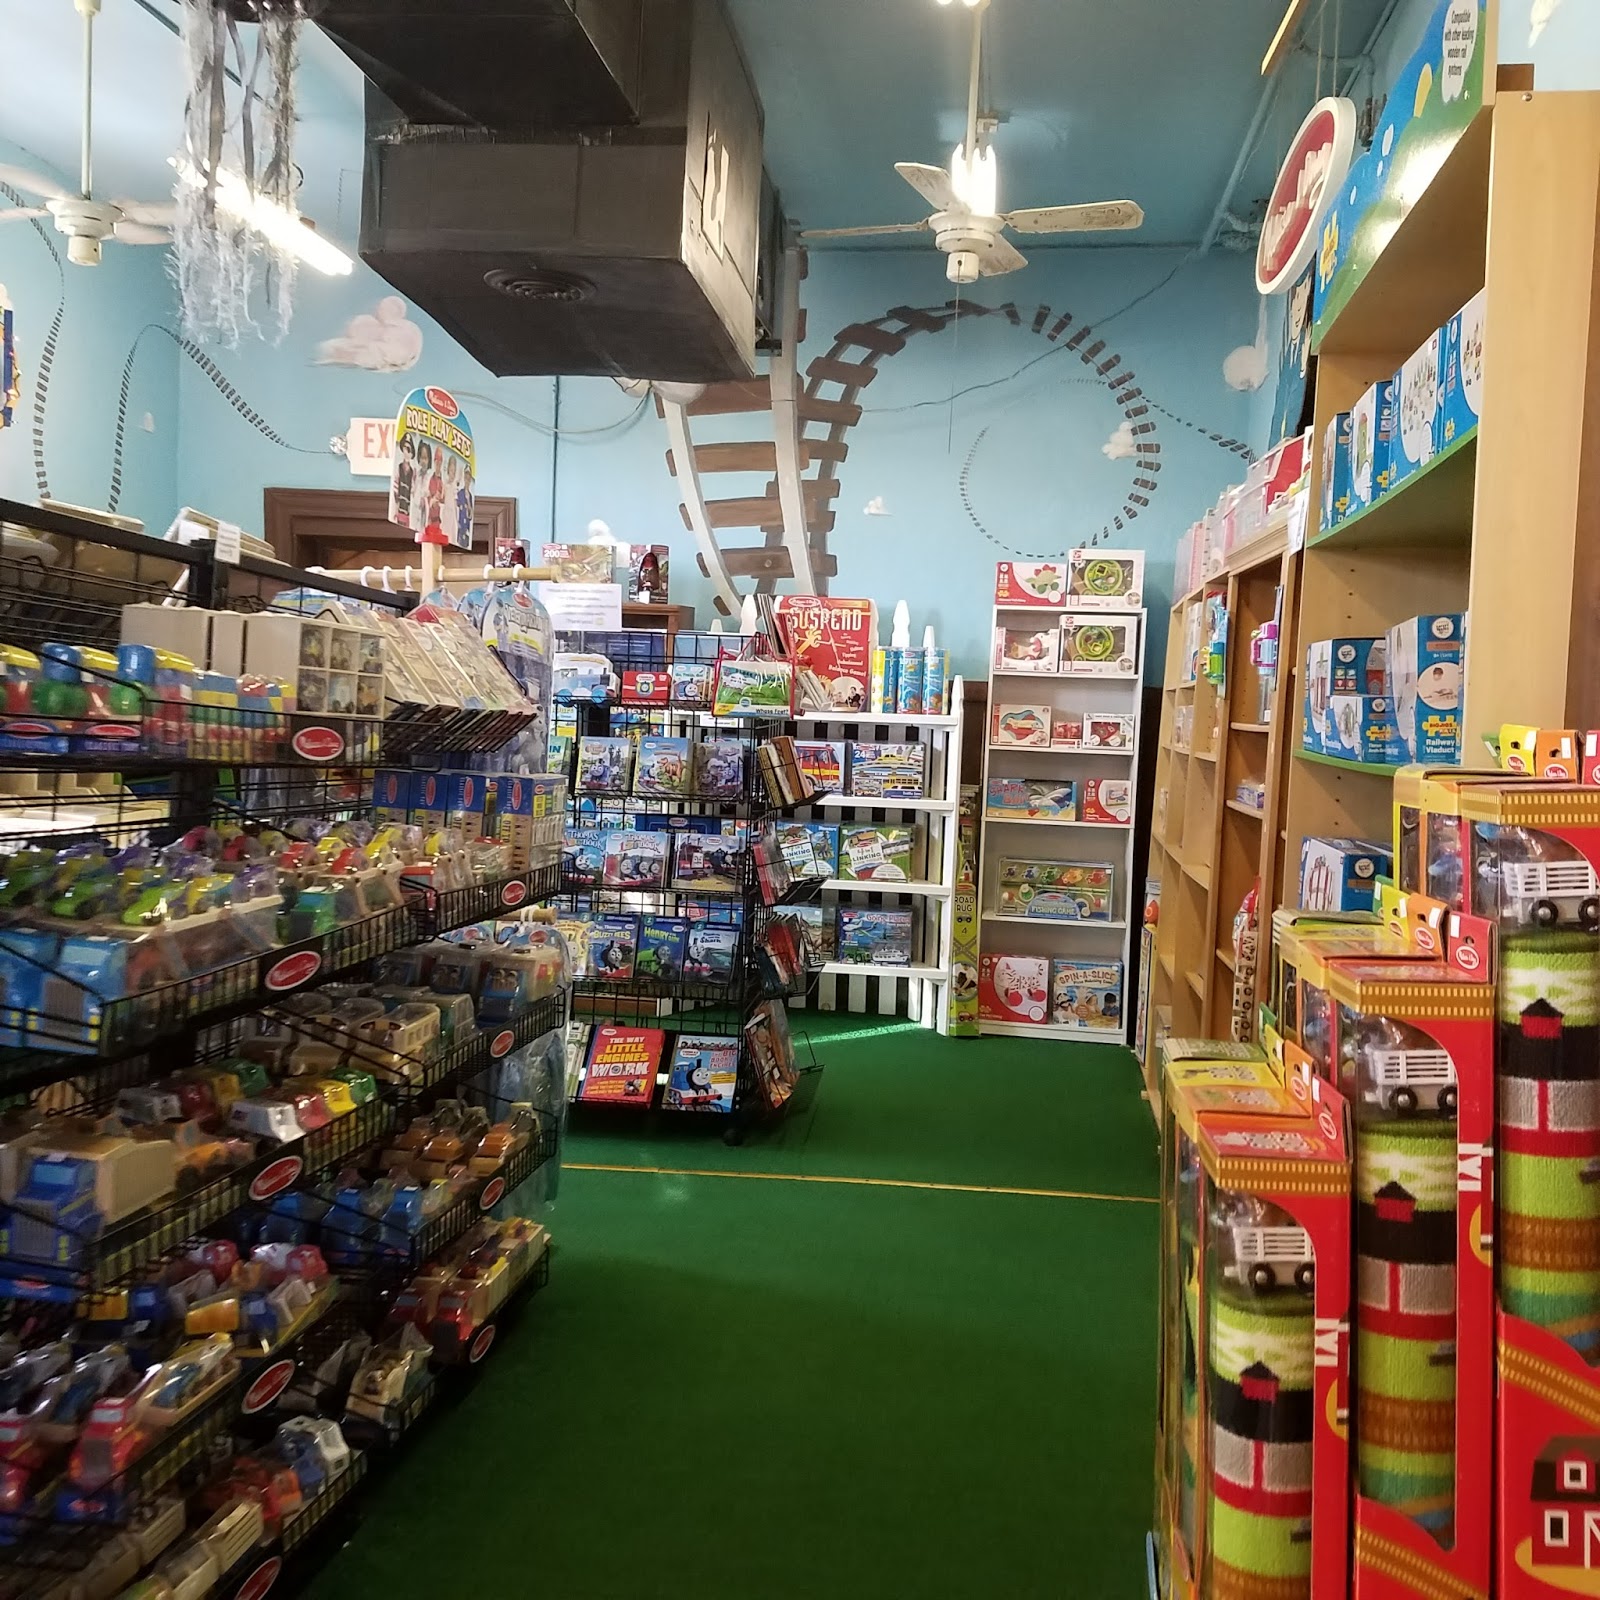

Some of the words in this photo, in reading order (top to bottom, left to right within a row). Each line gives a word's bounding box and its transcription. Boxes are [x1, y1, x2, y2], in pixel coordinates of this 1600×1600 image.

[406, 406, 428, 434] ROLE
[430, 414, 453, 445] PLAY
[451, 427, 472, 458] SETS
[364, 423, 396, 459] EXI
[543, 549, 560, 558] 200
[1426, 739, 1456, 747] Railway
[854, 750, 866, 758] 24
[502, 819, 511, 833] OFF
[784, 848, 811, 858] INKING
[852, 852, 881, 862] LINKING
[955, 896, 975, 904] ROAD
[957, 904, 972, 912] RUG
[1059, 970, 1116, 984] SPIN-A-SLICE
[605, 1043, 645, 1053] LITTLE
[595, 1052, 650, 1064] ENGINES
[591, 1061, 650, 1078] WORK
